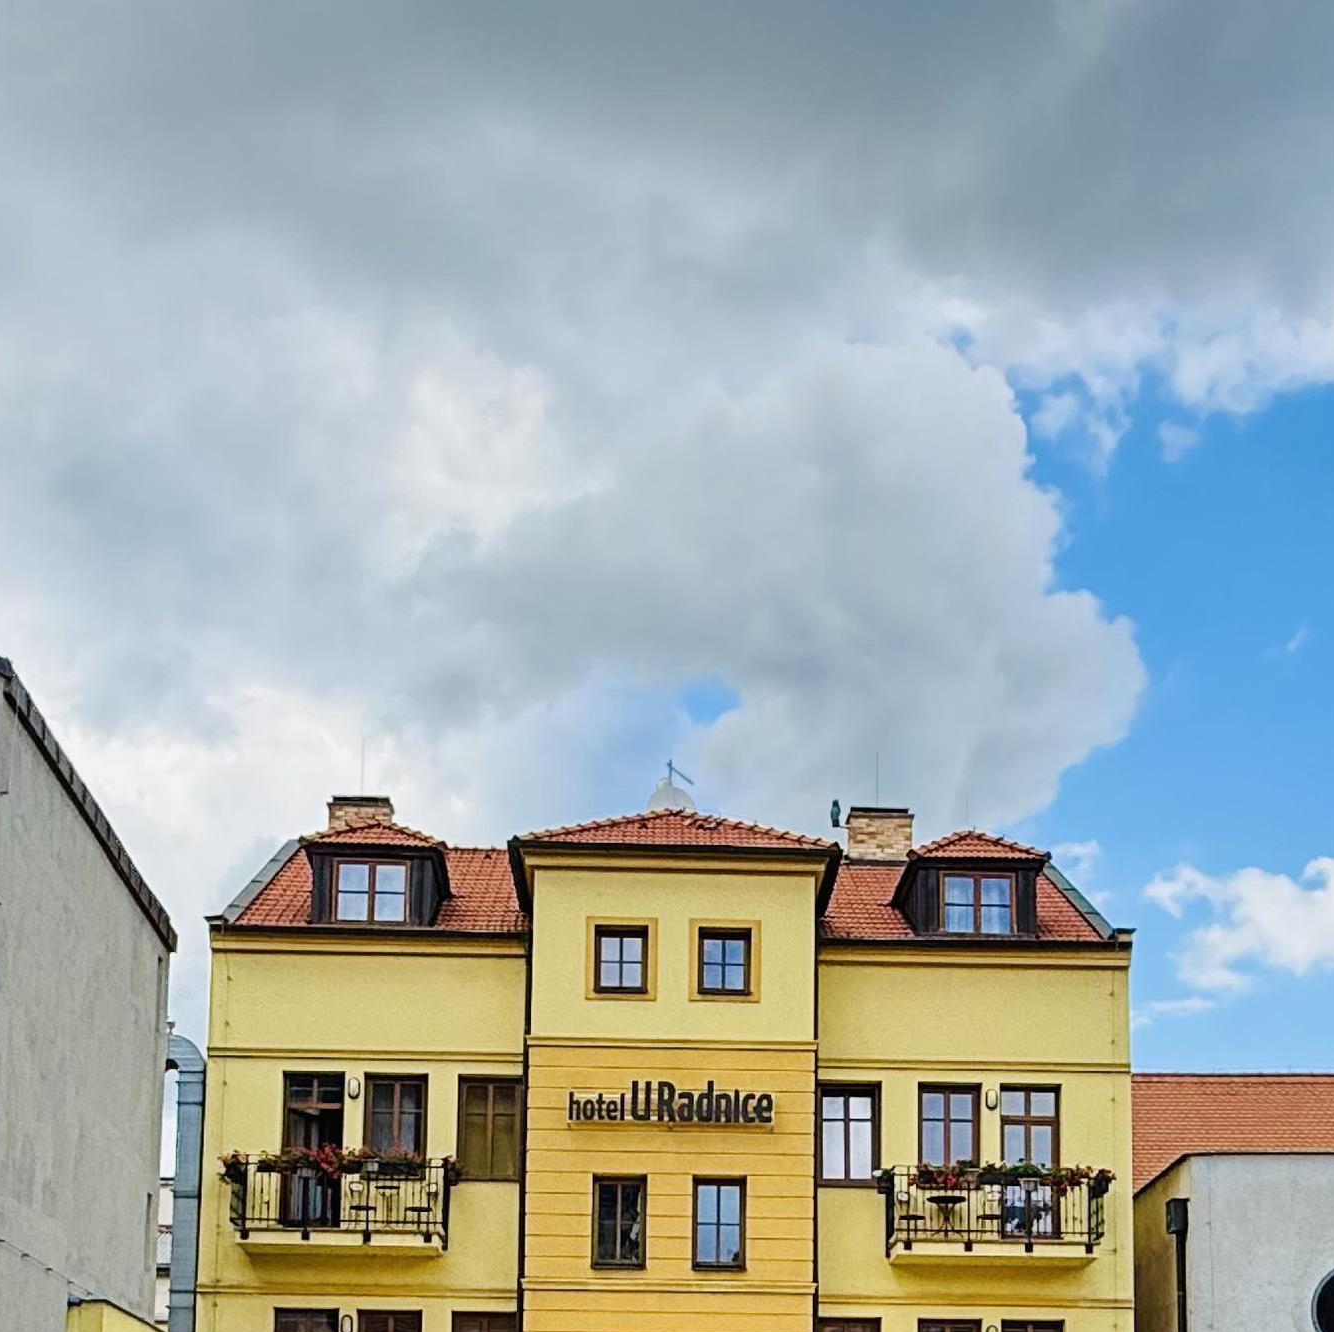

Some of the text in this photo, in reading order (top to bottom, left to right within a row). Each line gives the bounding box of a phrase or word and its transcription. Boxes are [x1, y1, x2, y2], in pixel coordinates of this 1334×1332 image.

[568, 1080, 774, 1124] hotel U Radnice
